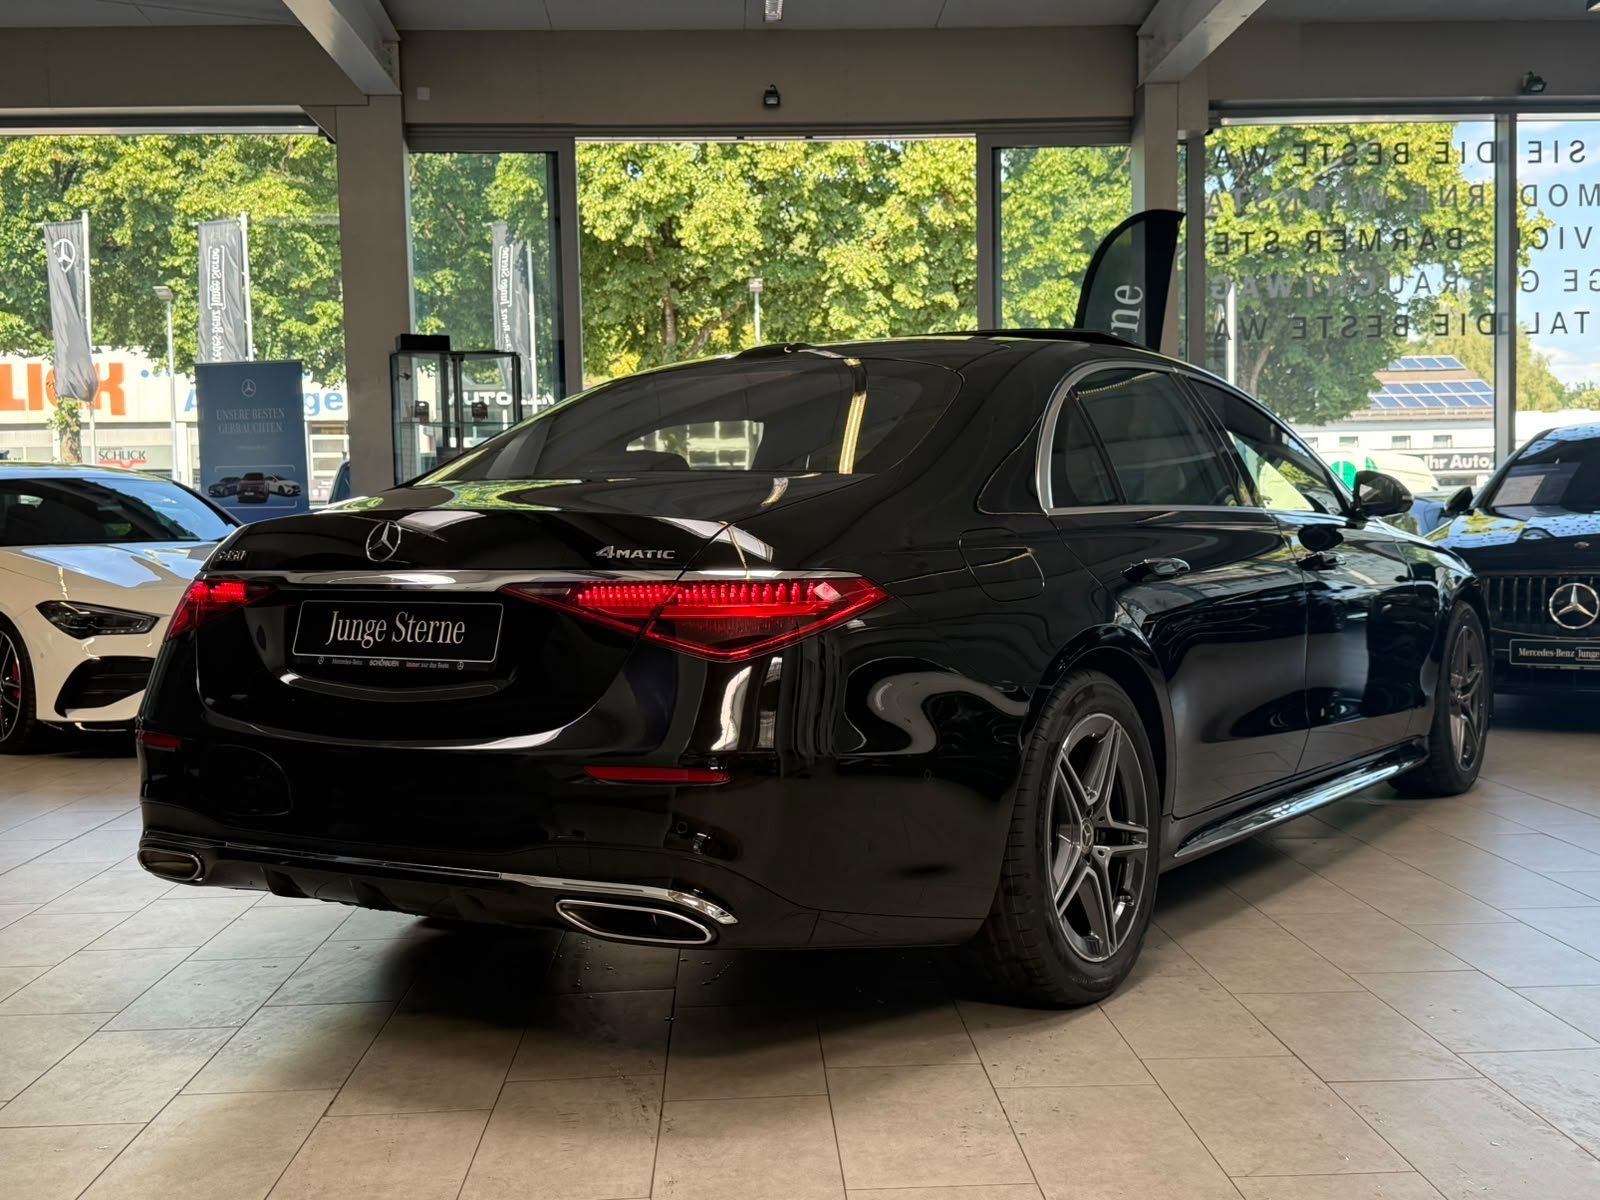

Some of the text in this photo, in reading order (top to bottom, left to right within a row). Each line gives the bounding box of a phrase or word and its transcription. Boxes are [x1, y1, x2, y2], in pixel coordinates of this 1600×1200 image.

[1110, 285, 1143, 338] ne
[216, 407, 286, 421] UNSERE BESTEN
[98, 450, 146, 460] SCHLICK
[1424, 454, 1448, 470] Ihr
[595, 545, 676, 559] 4MATIC
[325, 610, 466, 649] Junge Sterne
[1518, 648, 1575, 659] Mercedes-Benz
